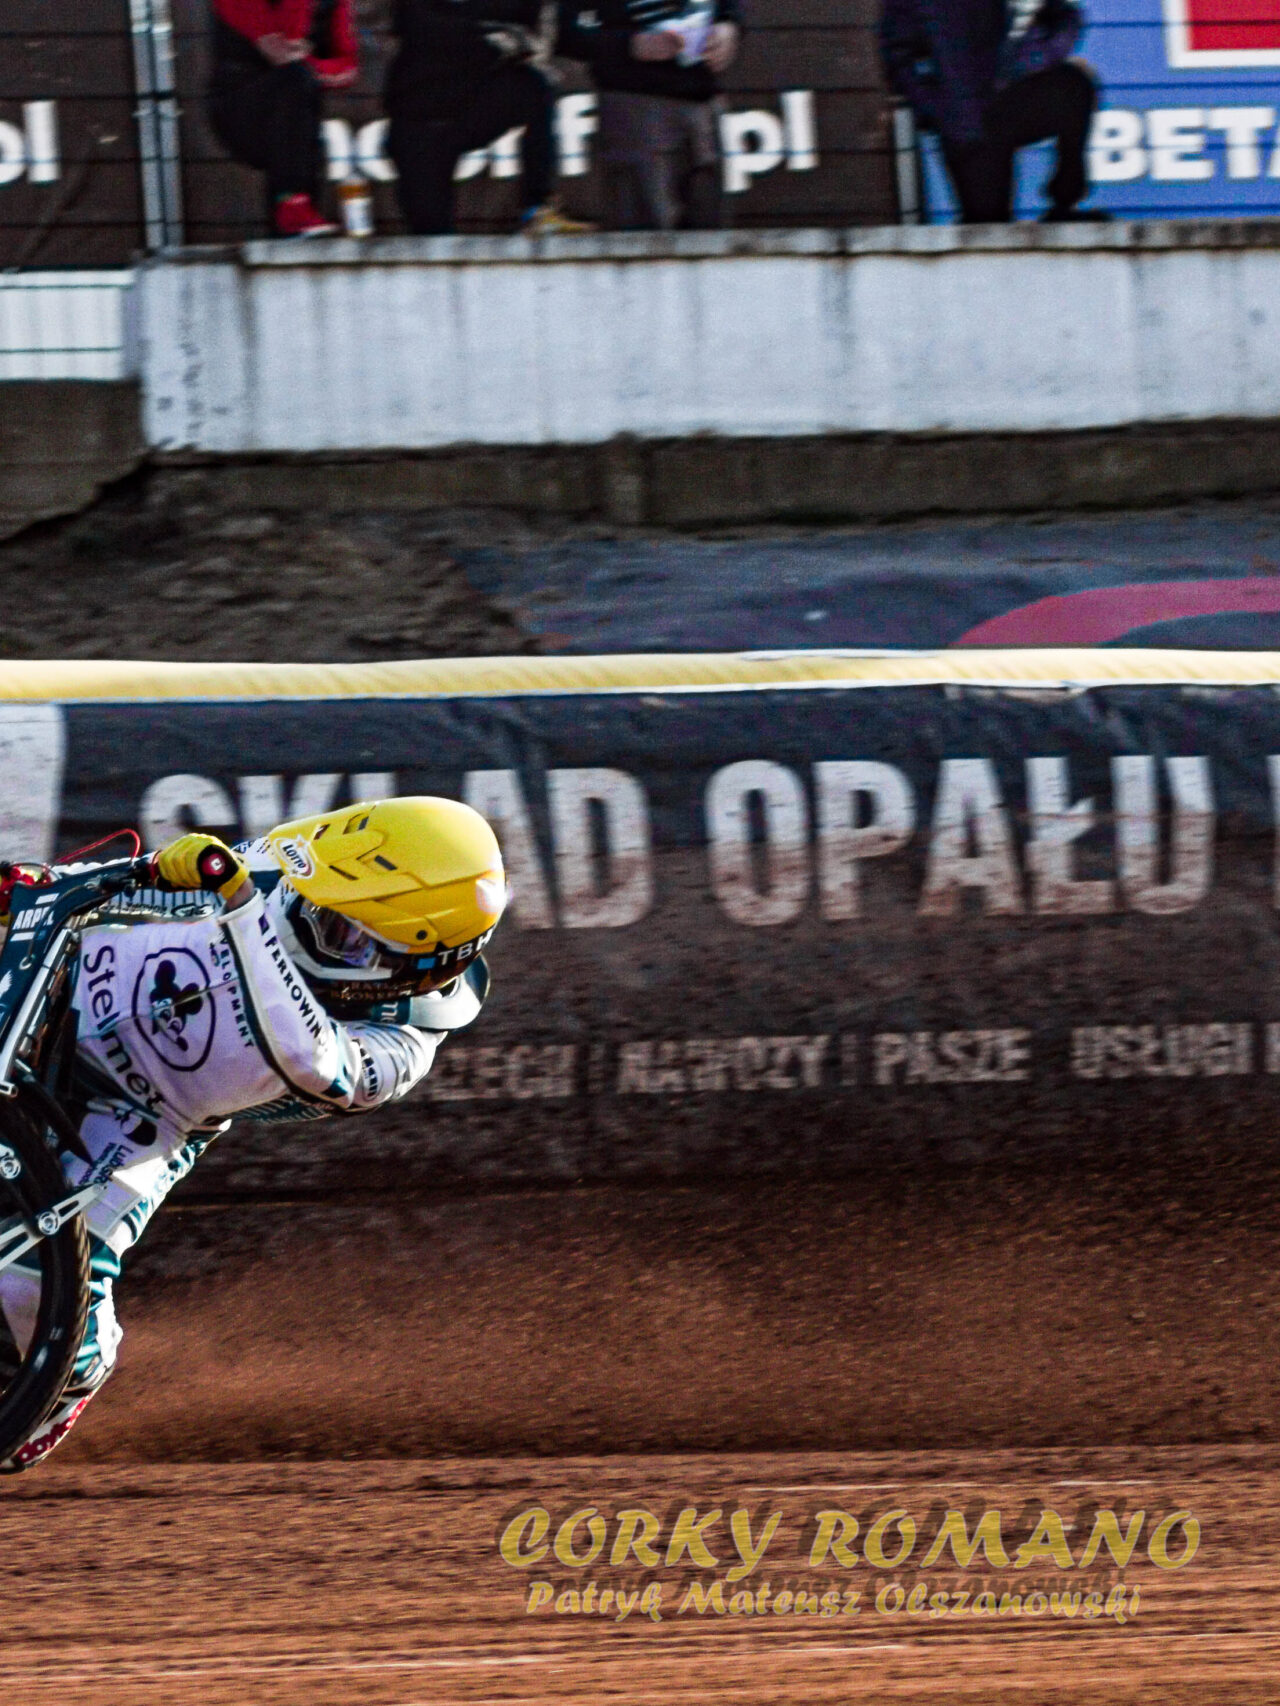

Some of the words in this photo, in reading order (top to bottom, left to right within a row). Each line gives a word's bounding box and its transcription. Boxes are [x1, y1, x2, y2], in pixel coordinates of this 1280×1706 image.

[282, 843, 307, 870] LOTTO
[704, 754, 1216, 926] OPAŁU
[872, 1028, 1031, 1086] PASZE
